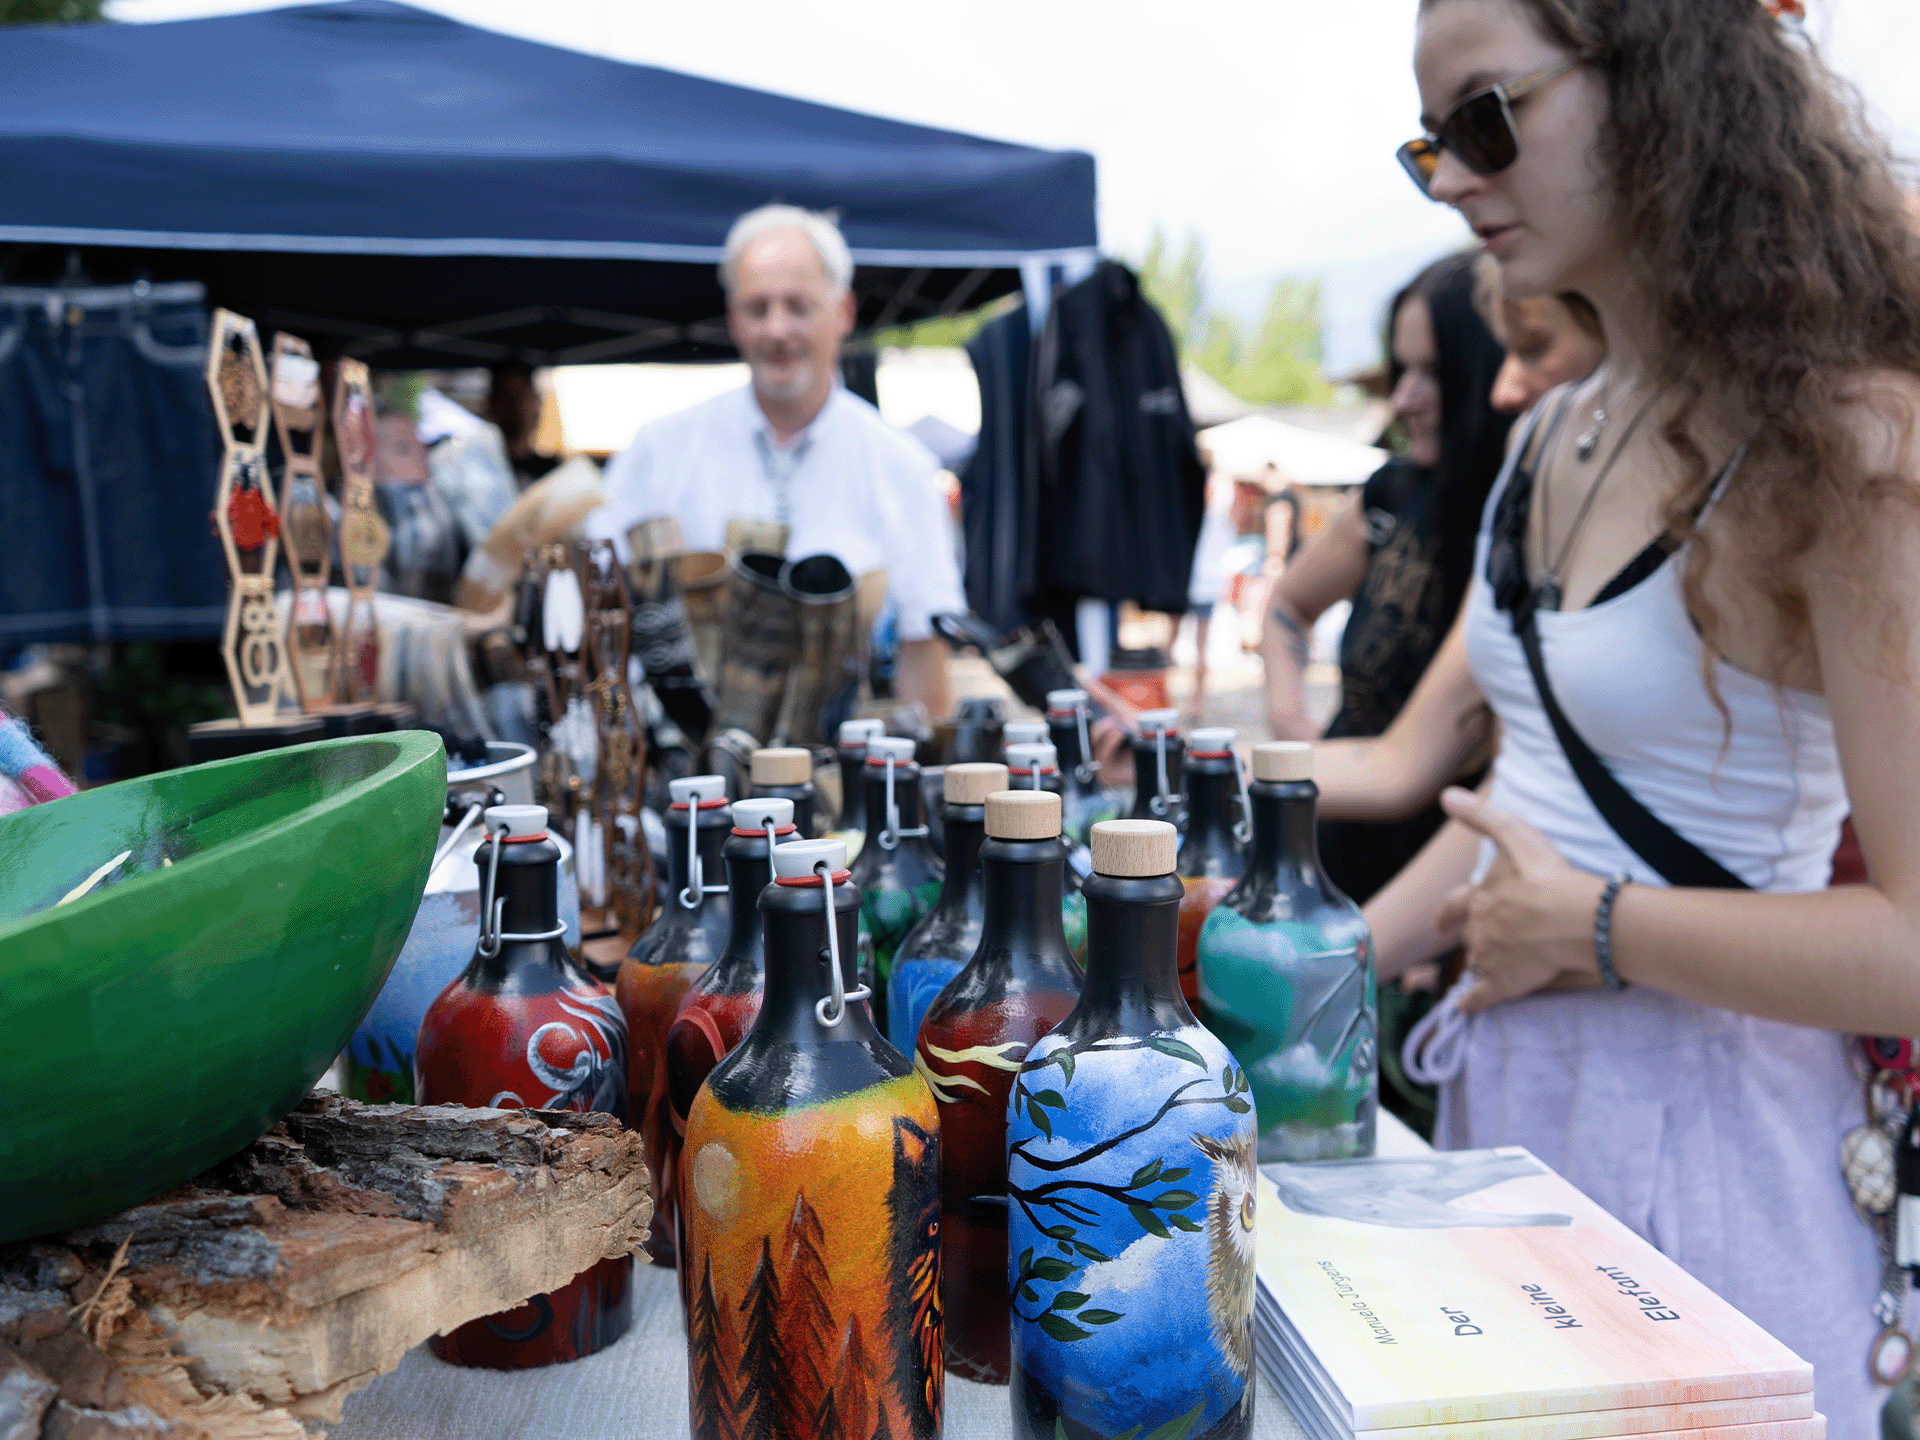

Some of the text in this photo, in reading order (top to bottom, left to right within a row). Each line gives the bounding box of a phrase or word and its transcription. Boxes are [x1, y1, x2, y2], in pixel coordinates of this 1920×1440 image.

[1317, 1261, 1399, 1344] Manuela Jürgens
[1521, 1284, 1583, 1328] kleine
[1596, 1265, 1680, 1321] Elefant
[1440, 1307, 1483, 1336] Der
